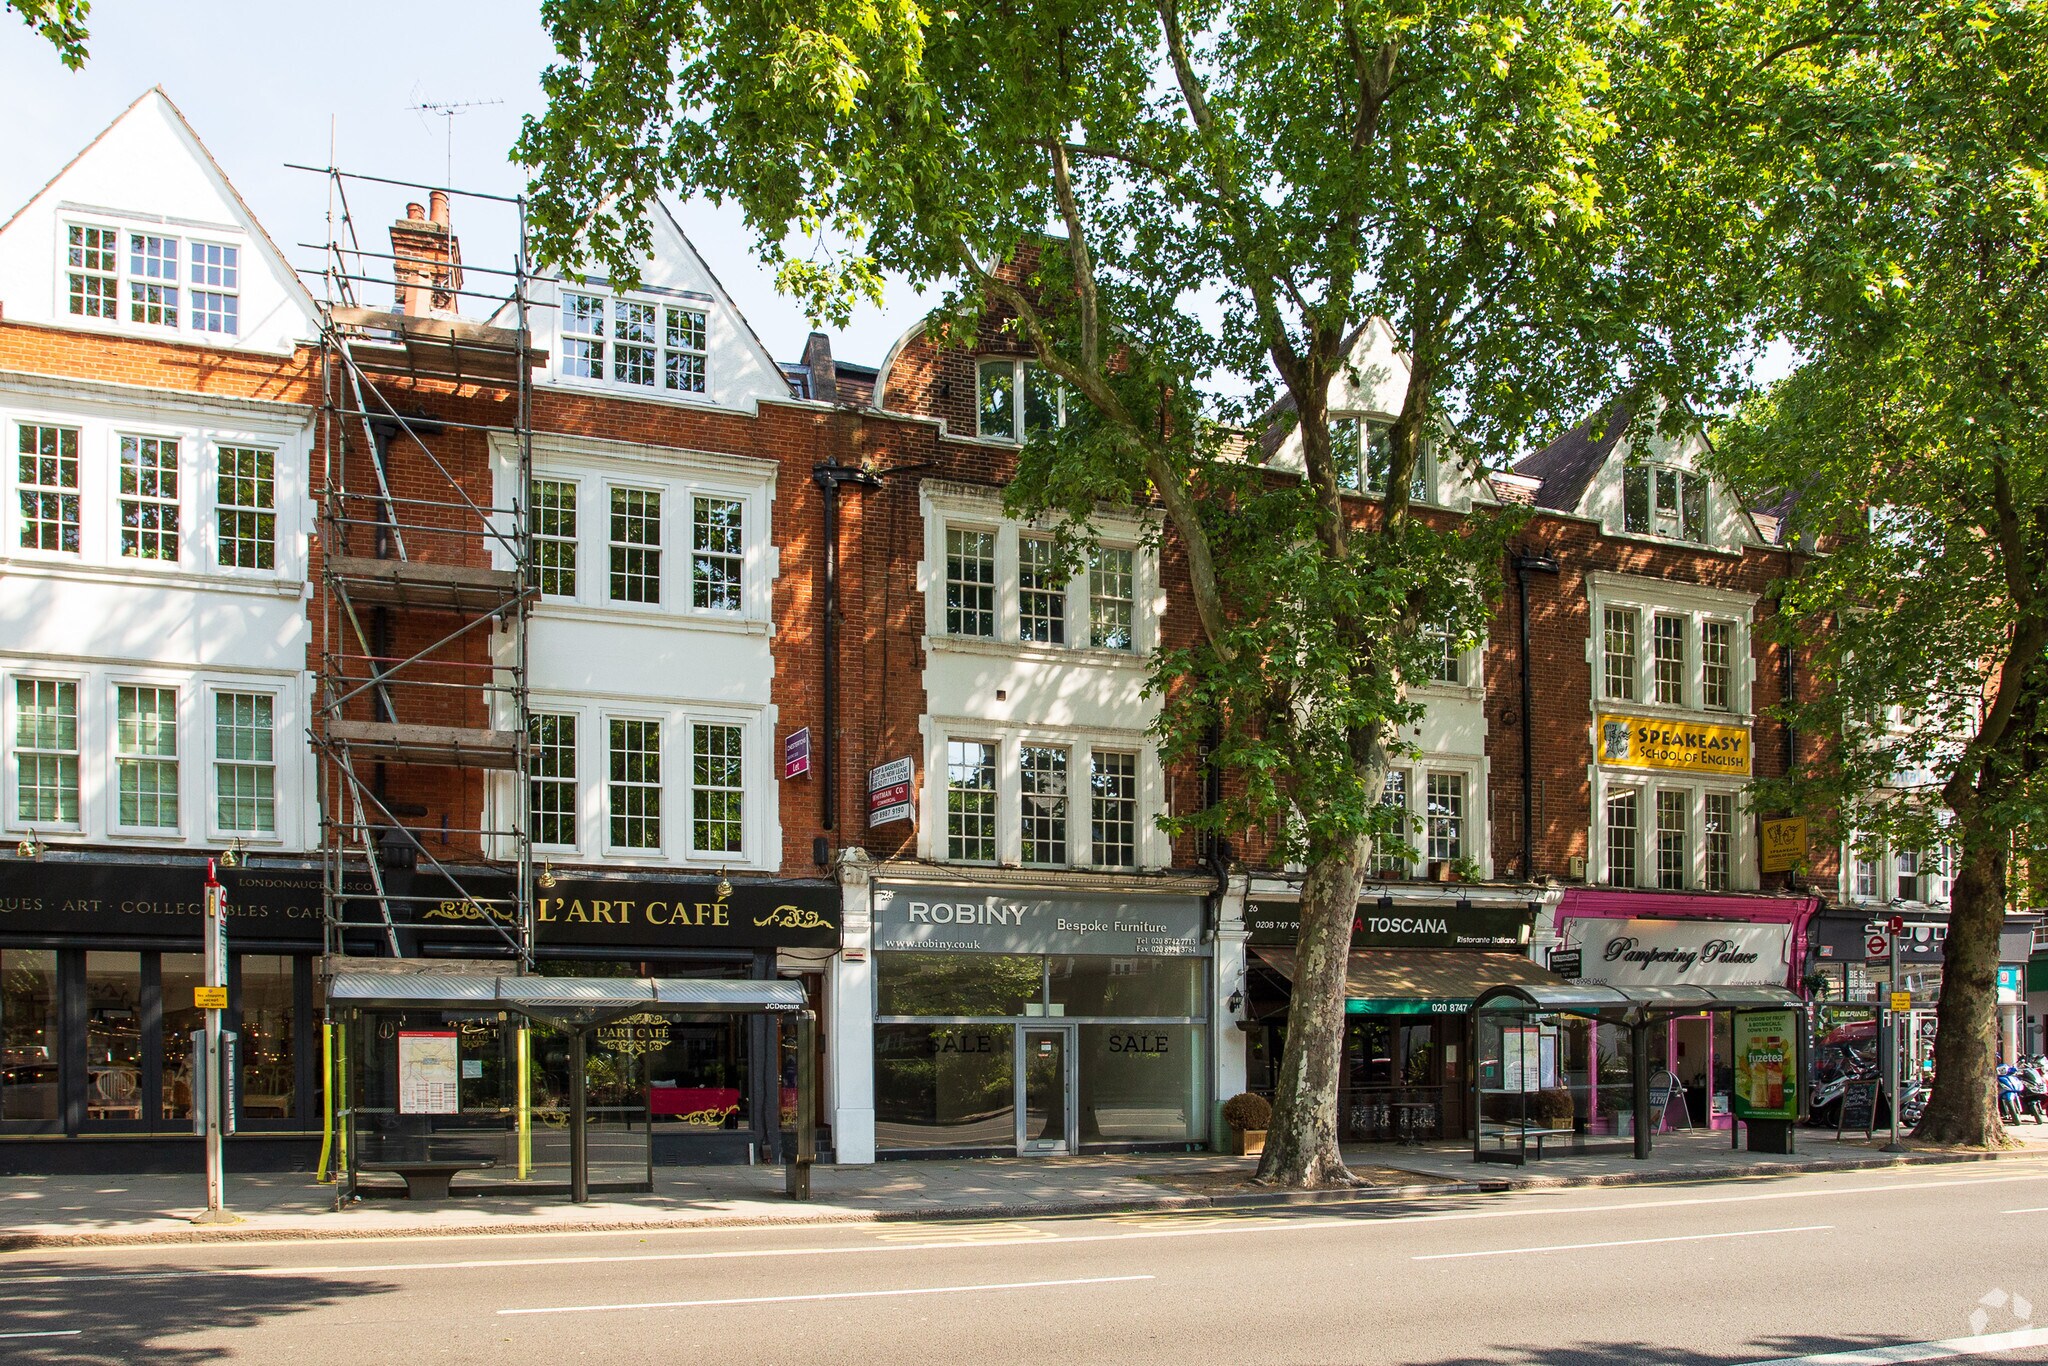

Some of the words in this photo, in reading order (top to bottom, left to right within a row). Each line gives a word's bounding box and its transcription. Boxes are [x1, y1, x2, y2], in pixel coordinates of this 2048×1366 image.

[1638, 727, 1742, 751] SPEAKEASY
[1640, 748, 1683, 763] SCHOOL
[1684, 752, 1698, 763] OF
[1701, 751, 1744, 768] ENGLISH
[896, 766, 908, 775] LEASE
[61, 900, 102, 912] ART
[121, 901, 269, 918] COLLECBLES
[286, 906, 325, 919] CAF
[537, 898, 635, 924] L'ART
[645, 896, 730, 926] CAFÉ
[908, 901, 1029, 926] ROBINY
[1057, 918, 1109, 935] Bespoke
[1114, 921, 1168, 933] Furniture
[1255, 921, 1274, 929] 0208
[1276, 921, 1288, 929] 747
[1368, 917, 1448, 934] TOSCANA
[1891, 920, 1898, 930] L
[885, 939, 981, 951] www.robiny.co.uk
[1151, 937, 1163, 945] 020
[1456, 936, 1491, 945] Ristorante
[1491, 936, 1517, 944] Italiano
[1136, 945, 1149, 953] Fax
[1603, 936, 1699, 973] Pampering
[1700, 939, 1758, 966] Palace
[1431, 1003, 1447, 1012] 020
[1449, 1003, 1467, 1012] 8747
[597, 1027, 633, 1038] L'ART
[926, 1035, 991, 1053] SALE
[1109, 1035, 1168, 1053] SALE
[1748, 1052, 1783, 1063] fuzetea
